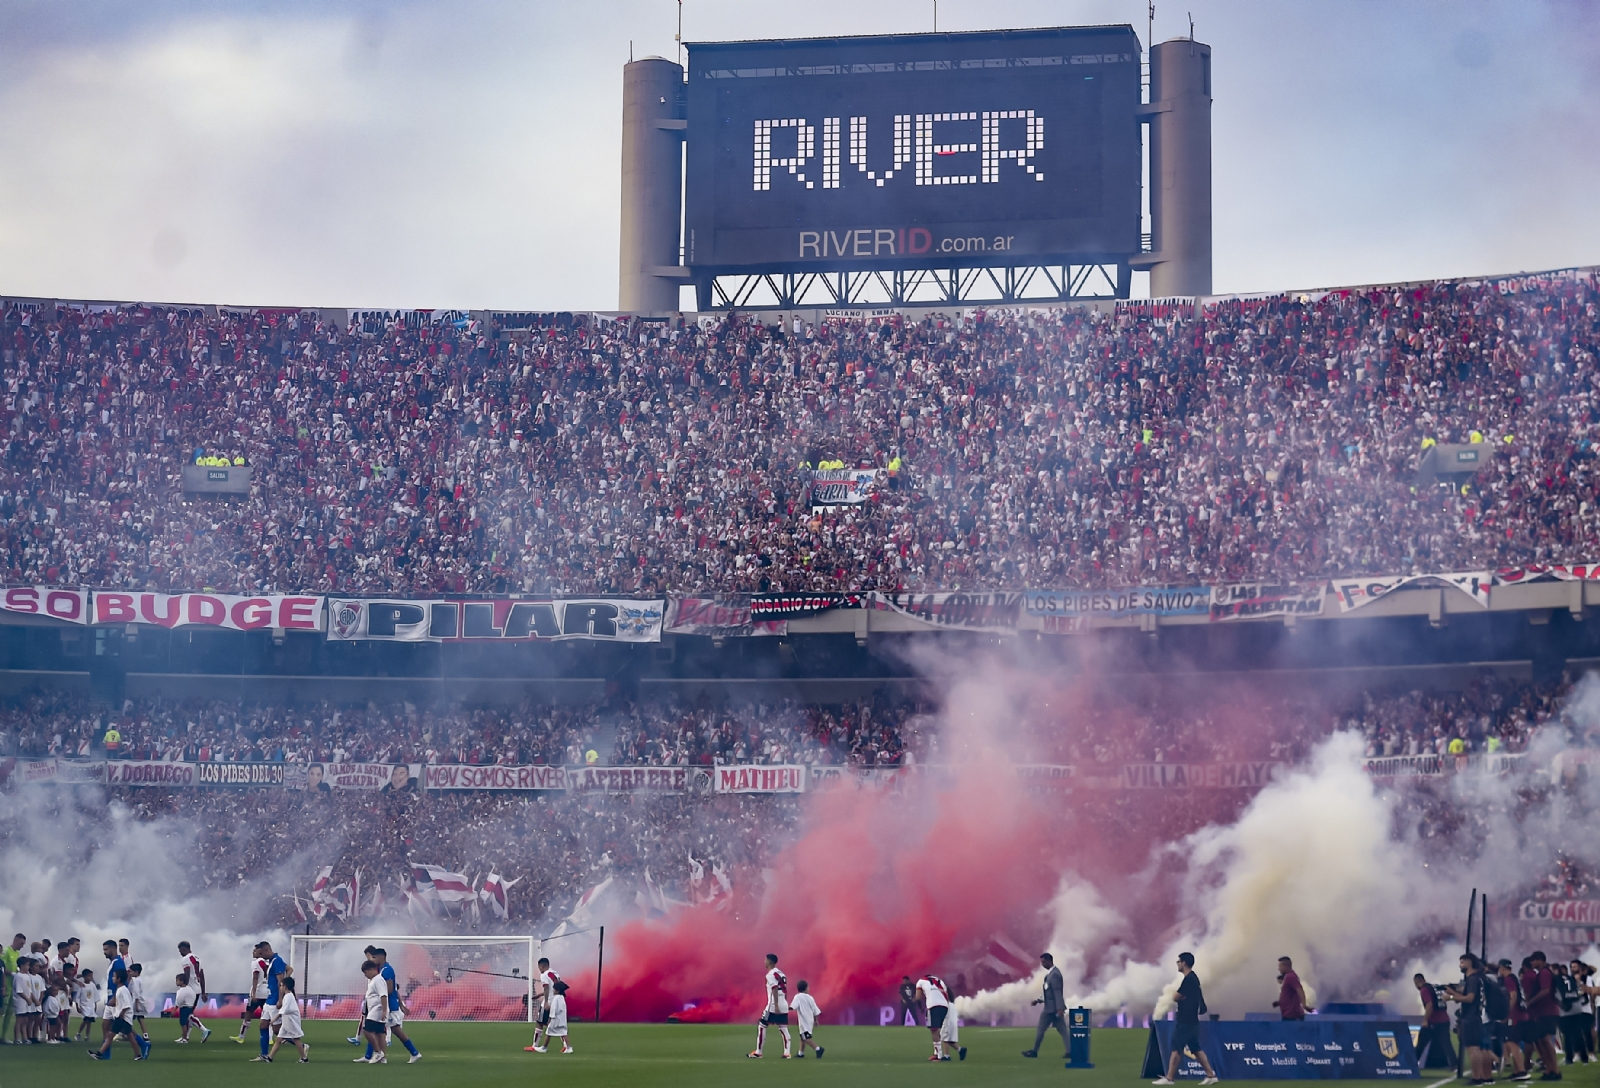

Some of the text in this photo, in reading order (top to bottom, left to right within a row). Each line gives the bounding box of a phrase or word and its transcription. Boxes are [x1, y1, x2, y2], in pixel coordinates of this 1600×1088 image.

[753, 109, 1045, 191] RIVER
[799, 227, 932, 258] RIVERID
[826, 309, 860, 317] LUCIANO
[1459, 452, 1475, 460] SALIDA
[814, 483, 848, 500] GARIN
[5, 588, 81, 620] SO
[751, 598, 802, 614] ROSARIO
[1026, 590, 1194, 613] LOS PIBES DE SAVIO
[96, 593, 317, 631] BUDGE
[368, 602, 619, 638] PILAR
[122, 764, 192, 784] DORREGO
[200, 764, 219, 783] LOS
[221, 764, 249, 783] PIBES
[252, 765, 270, 782] DEL
[272, 764, 283, 784] 30
[330, 764, 388, 779] VAMOS A ESTAR
[337, 775, 379, 786] SIEMPRE
[461, 767, 514, 788] SOMOS
[519, 767, 565, 788] RIVER
[570, 768, 685, 792] LAFERRERE
[721, 768, 800, 790] MATHEU
[1244, 1058, 1264, 1066] TCL
